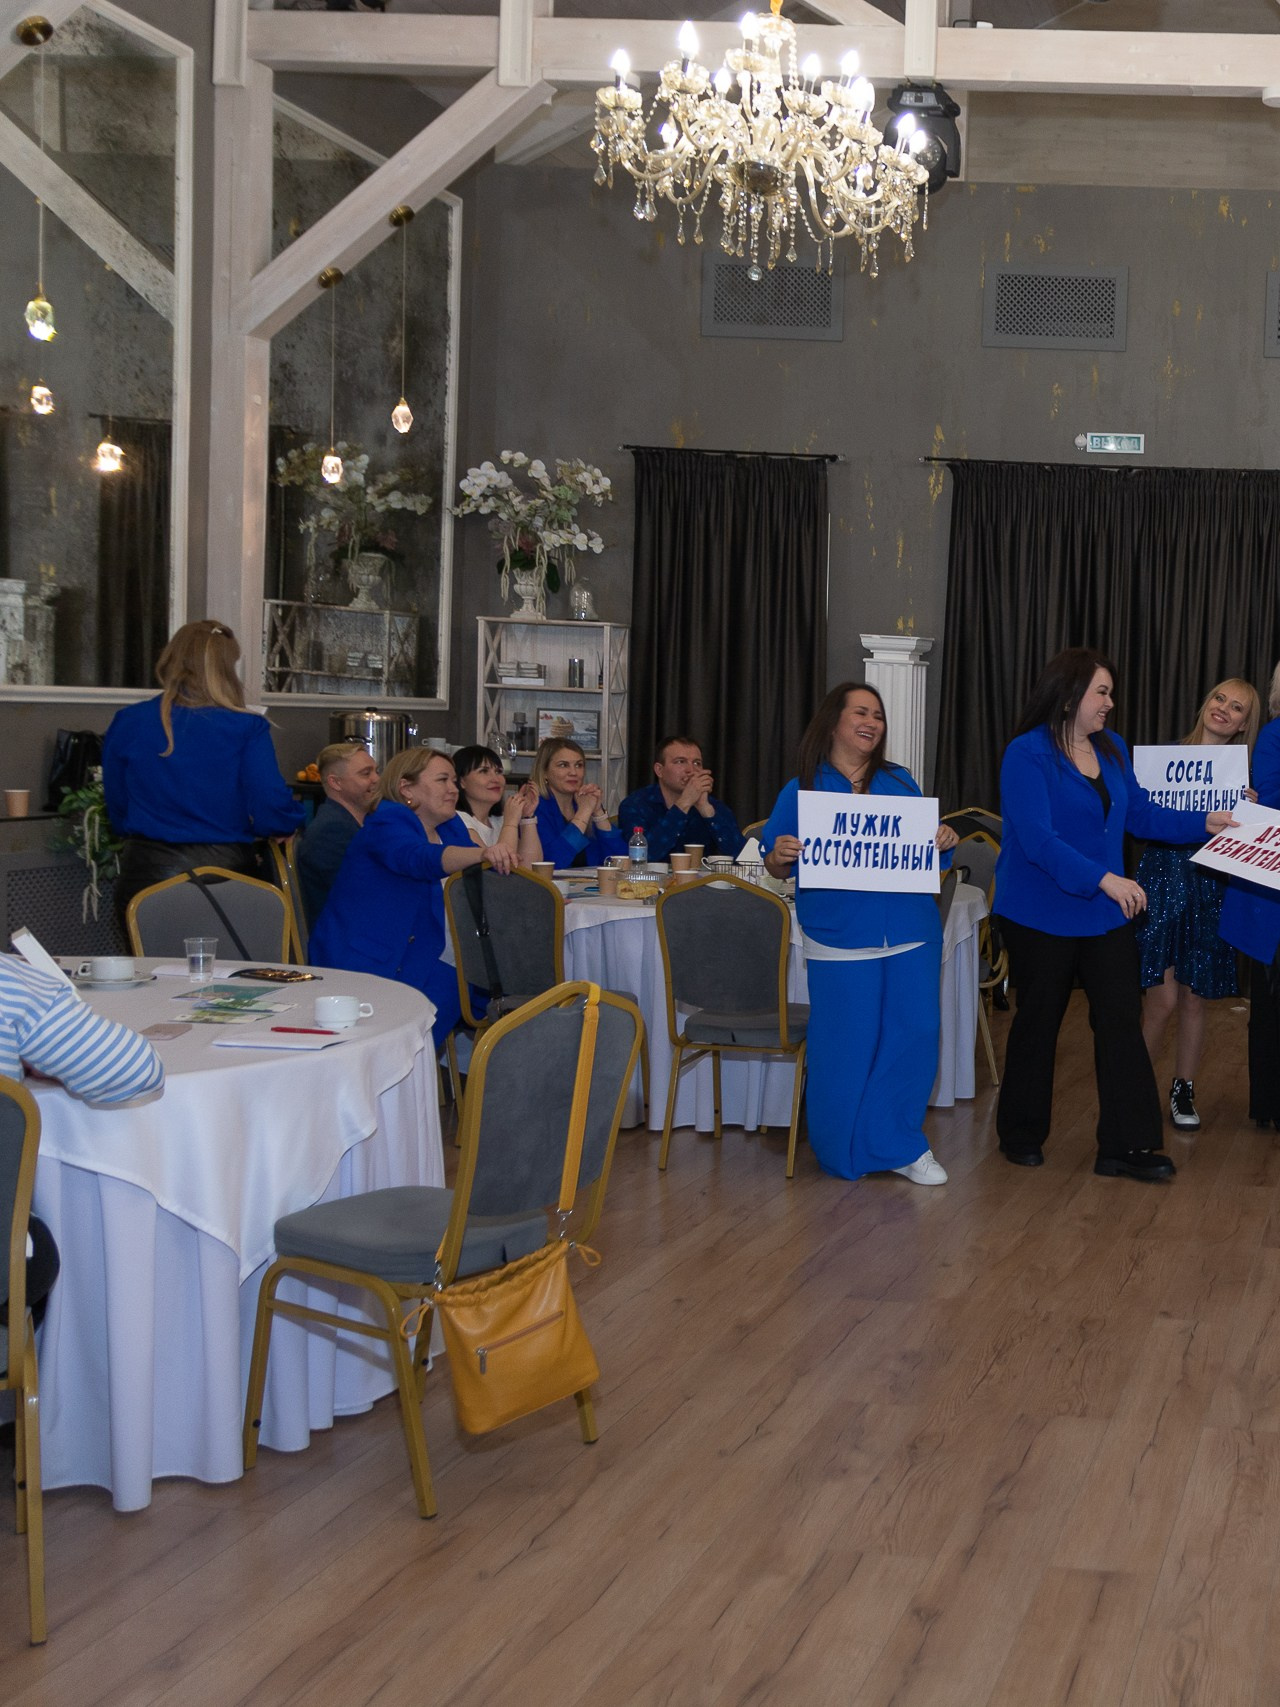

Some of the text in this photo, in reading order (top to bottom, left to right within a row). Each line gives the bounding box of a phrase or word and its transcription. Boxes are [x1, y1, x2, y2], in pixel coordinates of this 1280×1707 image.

[1165, 759, 1213, 785] СОСЕД
[1150, 785, 1246, 812] ЕЗЕНТАБЕЛЬНЫЙ
[832, 812, 902, 838] МУЖИК
[801, 837, 935, 871] СОСТОЯТЕЛЬНЫЙ
